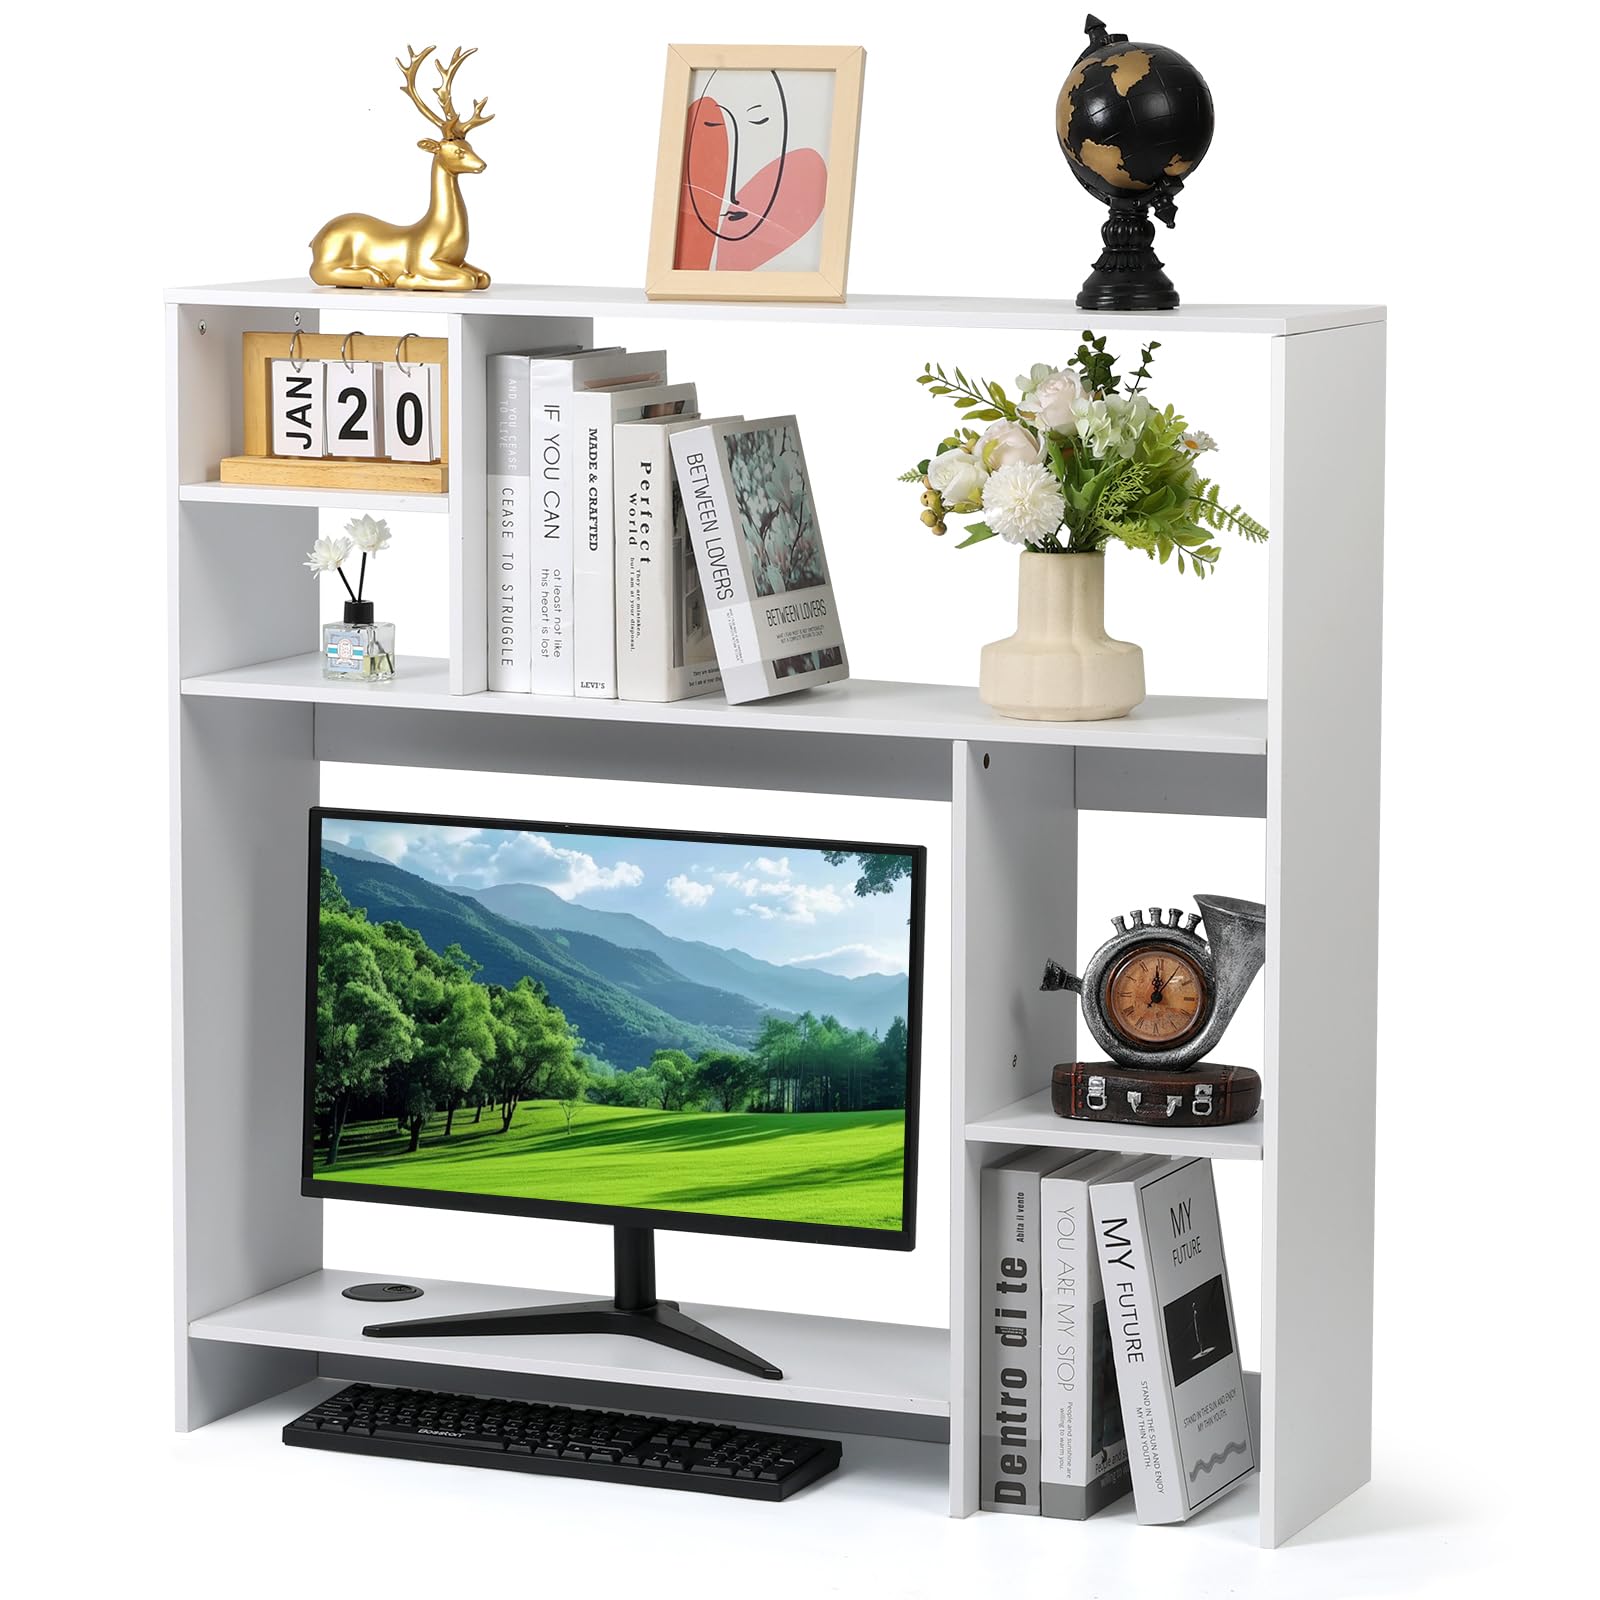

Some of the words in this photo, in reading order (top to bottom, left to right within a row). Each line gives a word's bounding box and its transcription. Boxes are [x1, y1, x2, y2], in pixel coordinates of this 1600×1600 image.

[508, 379, 517, 400] AND
[286, 377, 312, 450] JAN
[338, 387, 368, 440] 2
[396, 392, 423, 446] 0
[499, 401, 508, 413] TO
[508, 407, 517, 427] YOU
[544, 405, 560, 422] IF
[499, 421, 508, 448] LIVE
[588, 428, 598, 470] MADE
[508, 435, 517, 470] CEASE
[543, 434, 561, 480] YOU
[588, 473, 598, 483] &
[501, 488, 514, 539] CEASE
[543, 491, 561, 539] CAN
[588, 487, 598, 551] CRAFTED
[628, 493, 638, 545] World
[640, 462, 653, 563] Perfect
[686, 452, 719, 533] BETWEEN
[705, 537, 734, 601] LOVERS
[501, 553, 514, 571] TO
[553, 569, 562, 580] at
[541, 569, 550, 587] this
[541, 591, 550, 621] heart
[553, 586, 562, 612] least
[765, 605, 800, 627] BETWEEN
[801, 599, 827, 620] LOVERS
[501, 584, 514, 666] STRUGGLE
[553, 617, 562, 635] not
[541, 639, 550, 658] lost
[553, 639, 562, 658] like
[580, 681, 605, 689] LEVI'S
[1016, 1192, 1024, 1212] vento
[1057, 1207, 1075, 1250] YOU
[1170, 1197, 1192, 1238] MY
[1016, 1223, 1024, 1243] Abita
[1101, 1218, 1136, 1270] MY
[1172, 1236, 1202, 1267] FUTURE
[996, 1257, 1027, 1294] te
[1057, 1259, 1075, 1295] ARE
[994, 1308, 1027, 1347] di
[1057, 1304, 1075, 1337] MY
[1116, 1282, 1145, 1363] FUTURE
[1057, 1344, 1075, 1391] STOP
[1141, 1380, 1150, 1407] STAND
[1136, 1407, 1142, 1419] MY
[1144, 1408, 1152, 1417] IN
[1146, 1418, 1155, 1433] THE
[994, 1368, 1027, 1505] Dentro
[1149, 1435, 1157, 1451] SUN
[1152, 1453, 1160, 1469] AND
[1155, 1471, 1164, 1494] ENJOY
